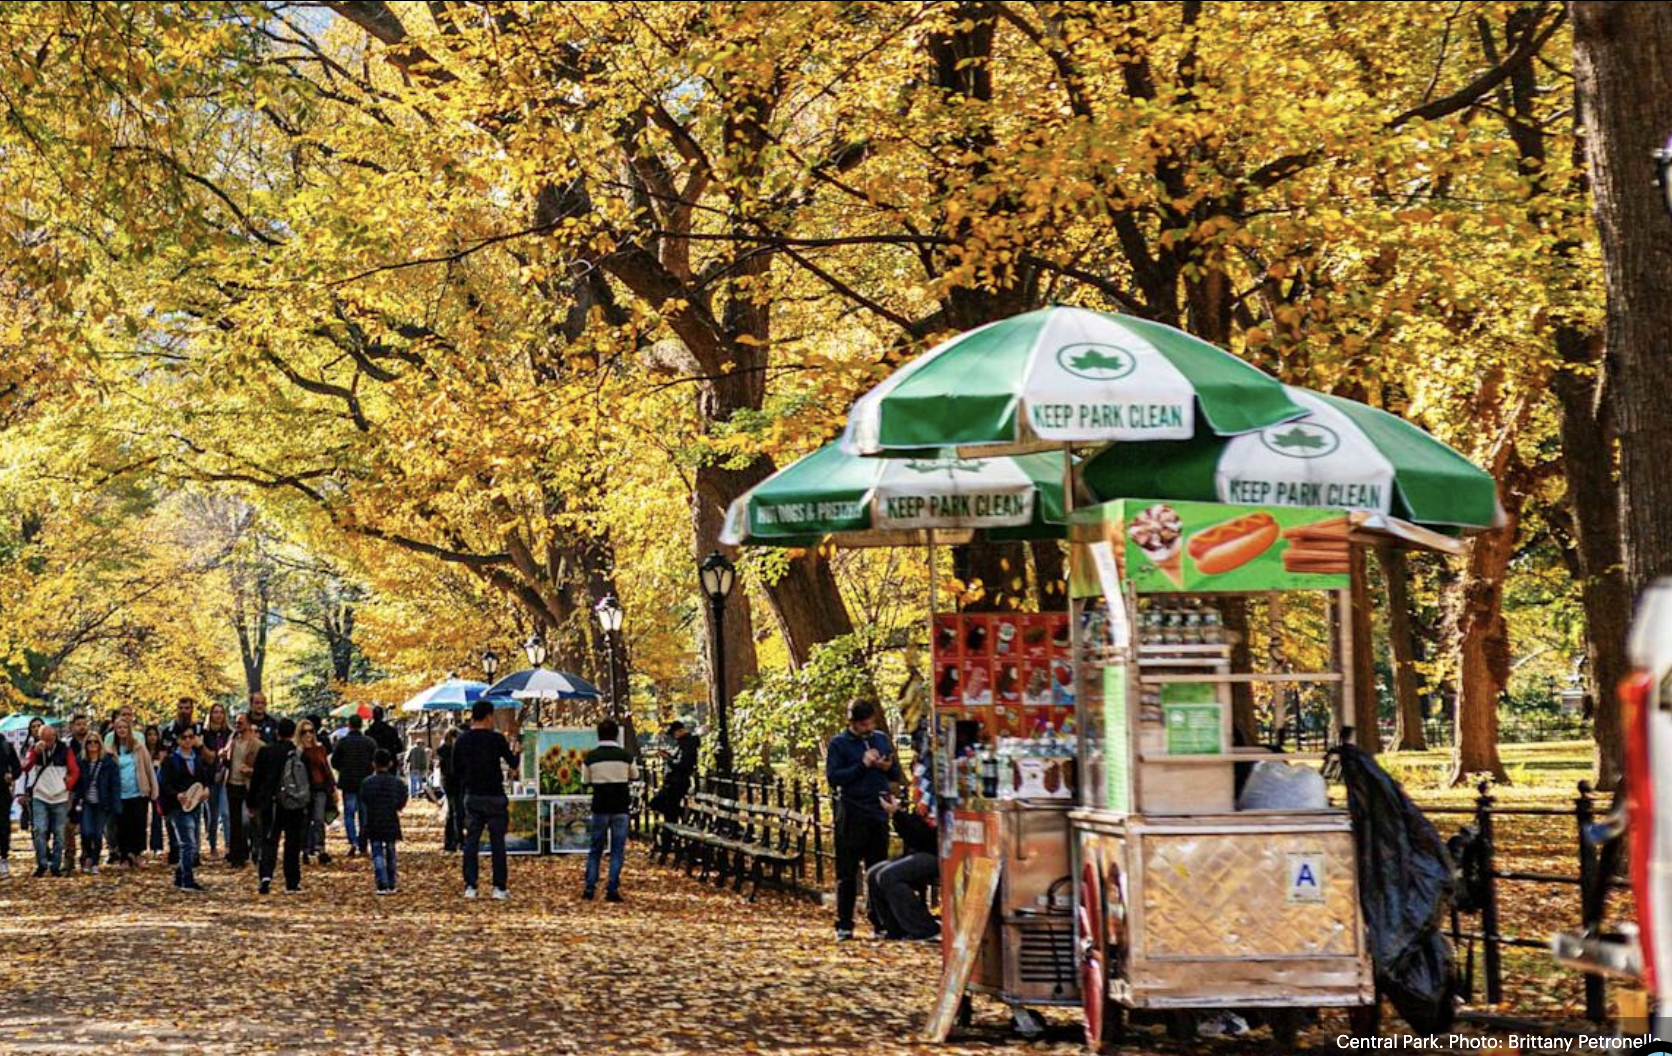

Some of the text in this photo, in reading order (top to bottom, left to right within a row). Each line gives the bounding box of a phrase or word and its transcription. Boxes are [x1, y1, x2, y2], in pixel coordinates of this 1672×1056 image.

[1032, 404, 1183, 429] KEEP PARK CLEAN
[886, 493, 1024, 519] KEEP PARK CLEAN
[1230, 479, 1382, 508] KEEP PARK CLEAN
[778, 503, 805, 523] DOGS
[806, 502, 816, 521] &
[1296, 863, 1317, 887] A
